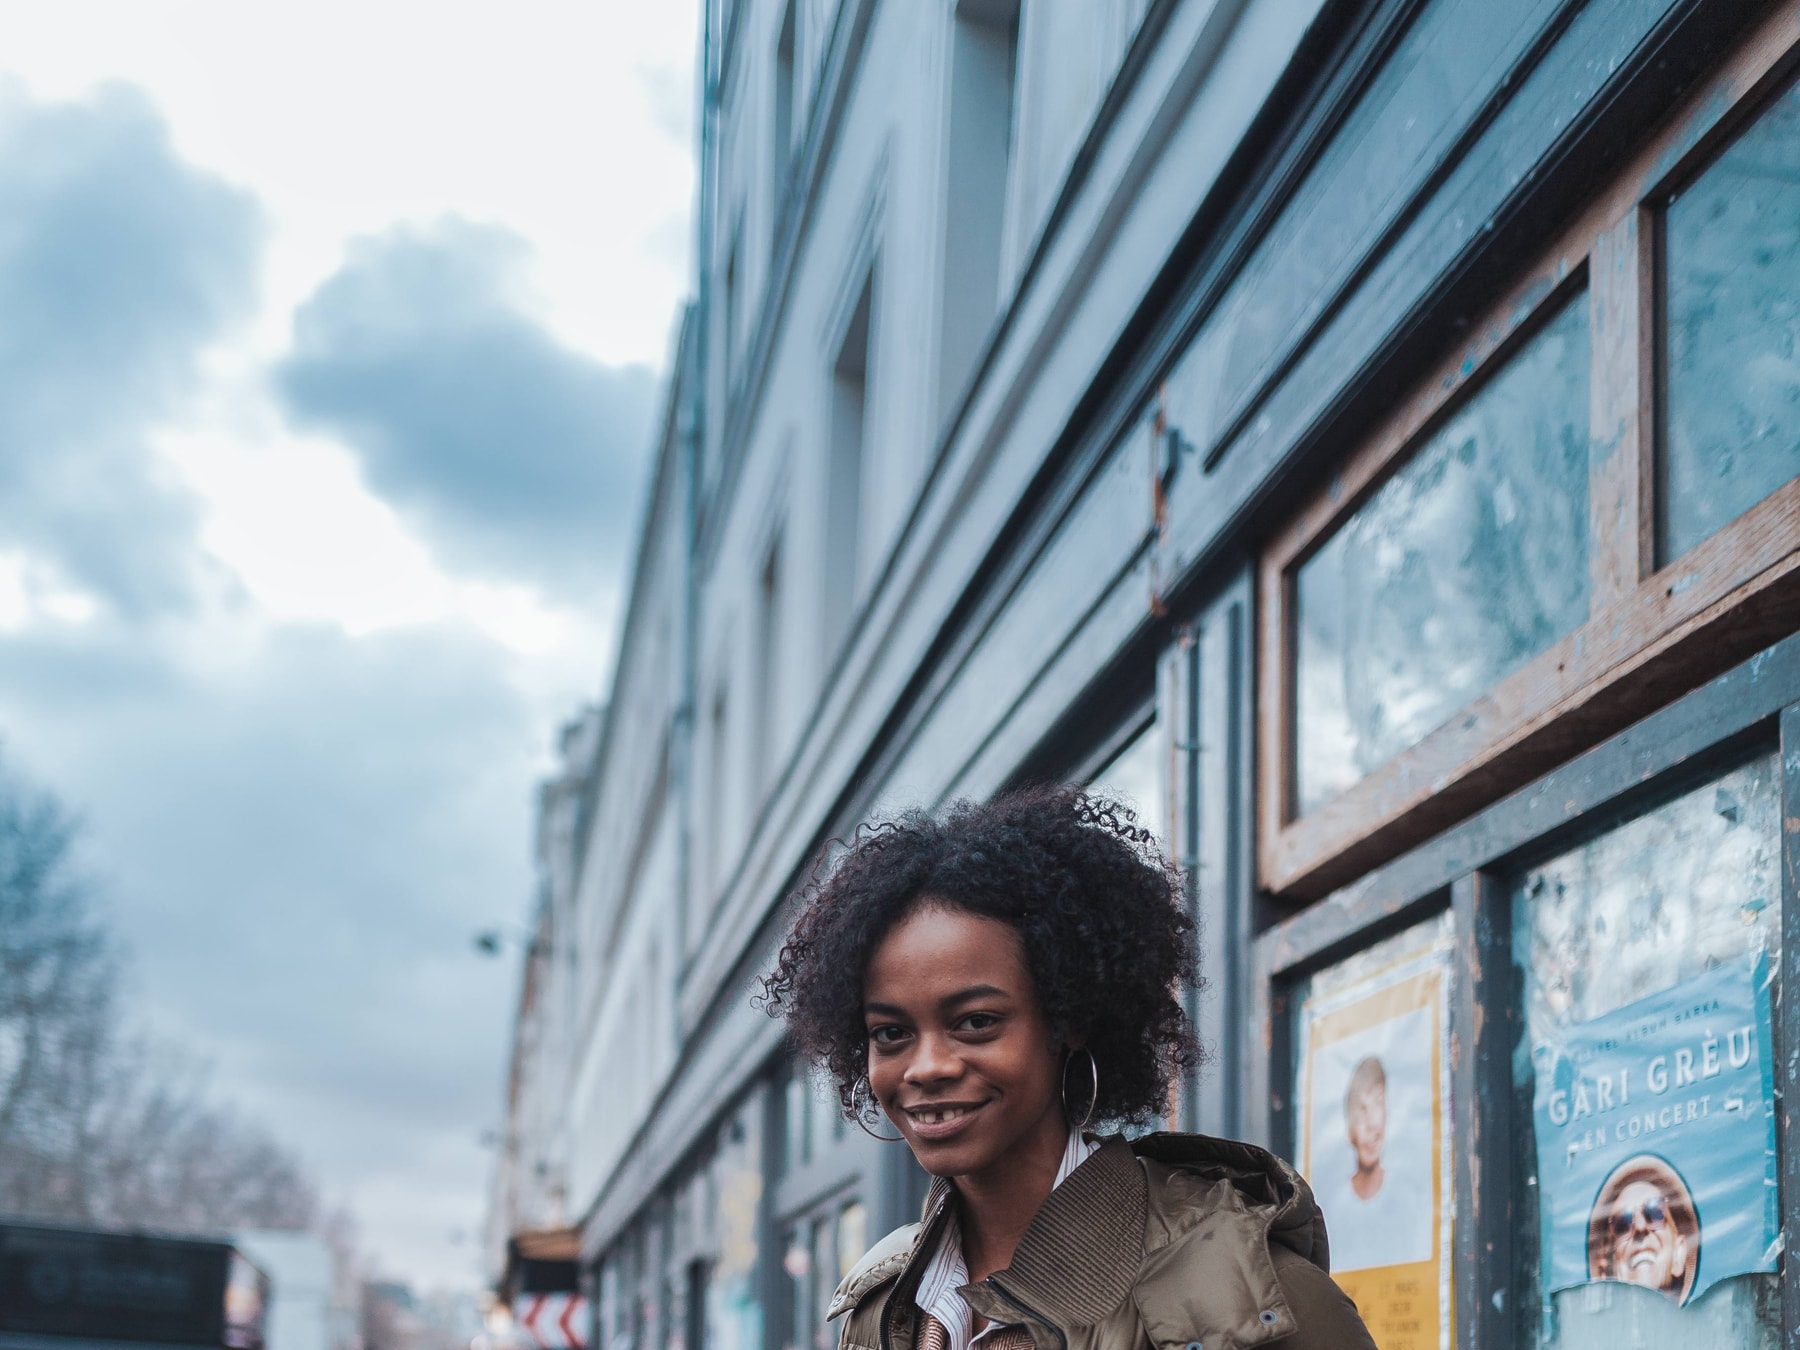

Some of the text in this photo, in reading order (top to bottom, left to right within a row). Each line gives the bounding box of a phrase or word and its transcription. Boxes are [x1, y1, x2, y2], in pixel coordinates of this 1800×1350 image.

[1626, 1019, 1667, 1042] ALBUM
[1549, 1026, 1753, 1127] GARI GRÈU
[1583, 1095, 1712, 1151] EN CONCERT
